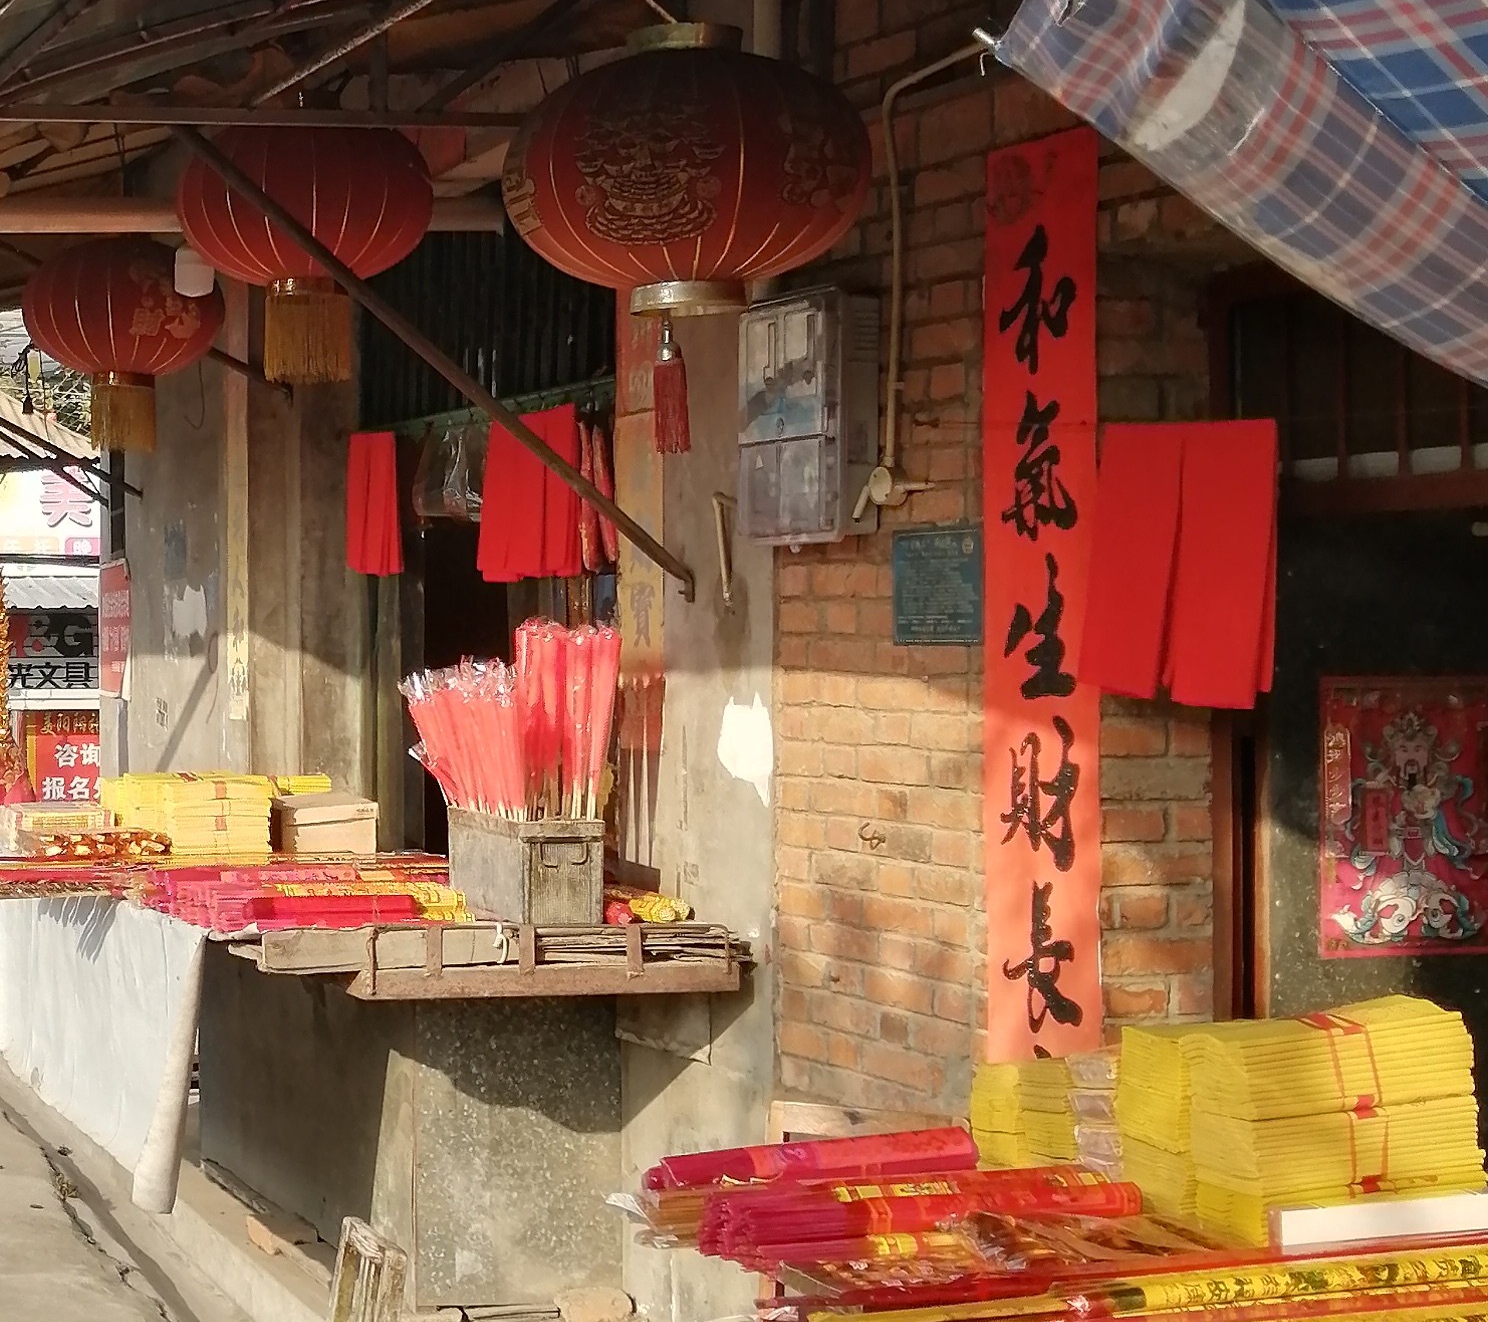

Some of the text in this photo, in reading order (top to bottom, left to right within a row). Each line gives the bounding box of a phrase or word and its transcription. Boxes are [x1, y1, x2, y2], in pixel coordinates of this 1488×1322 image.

[54, 741, 101, 768] 咨询
[999, 223, 1084, 1058] 和氣生財長
